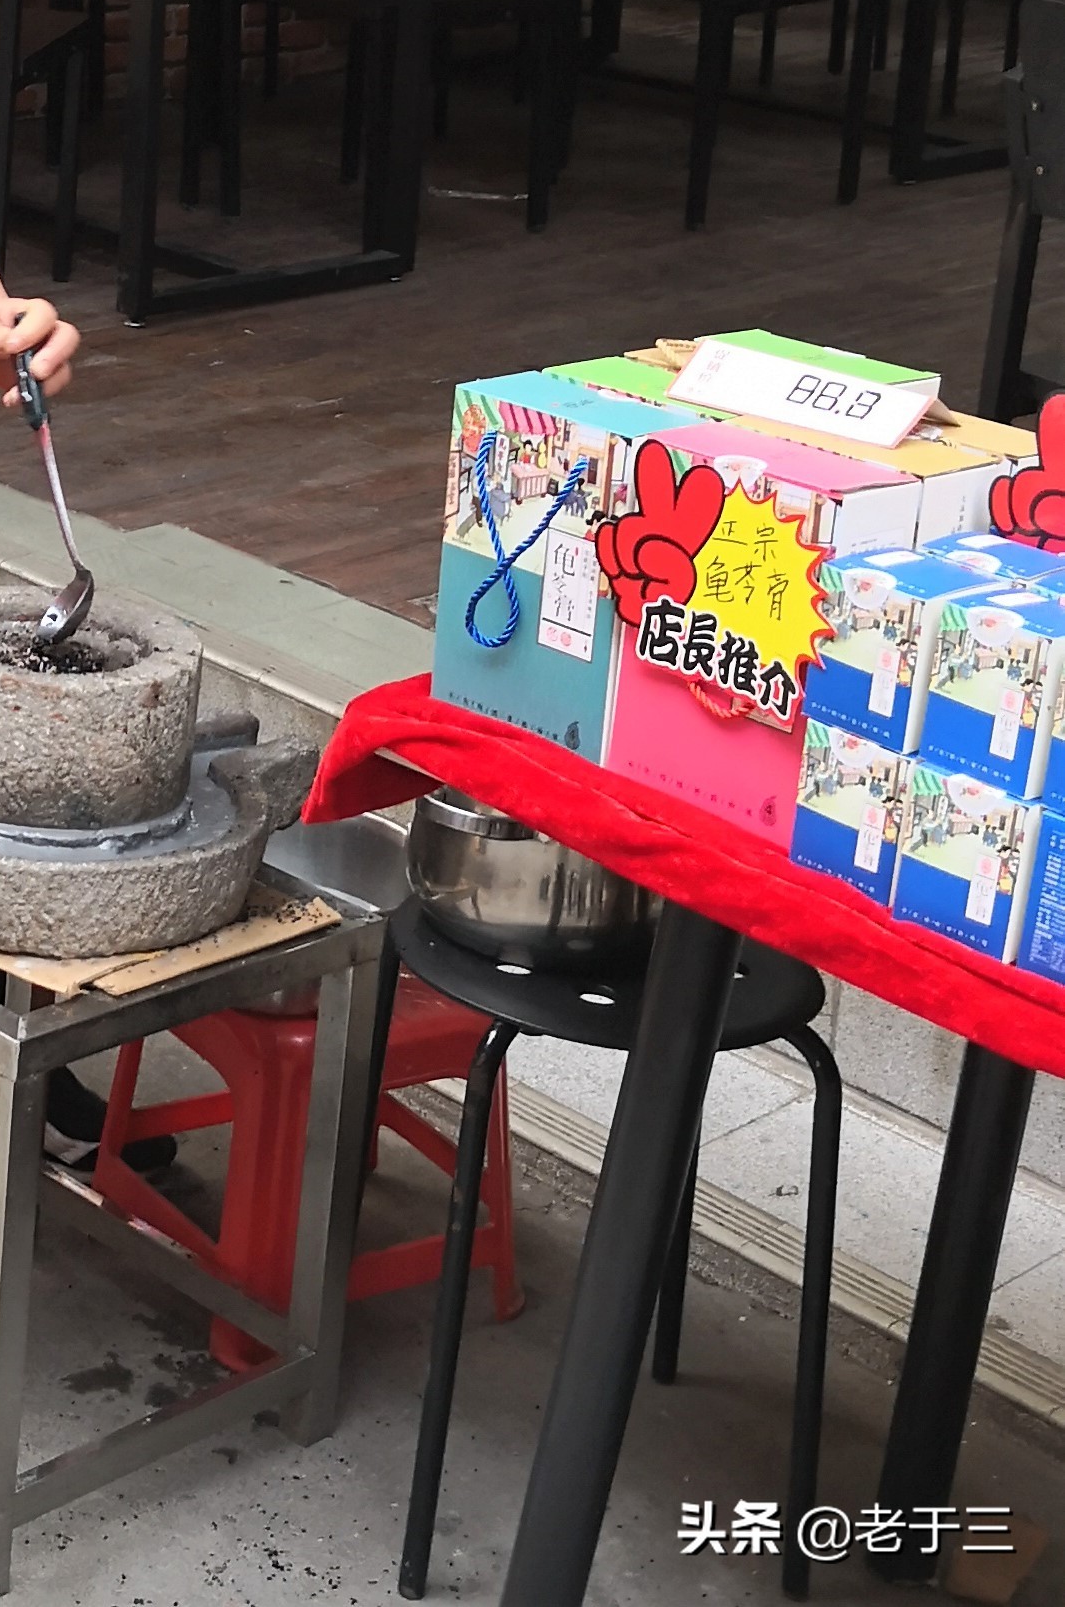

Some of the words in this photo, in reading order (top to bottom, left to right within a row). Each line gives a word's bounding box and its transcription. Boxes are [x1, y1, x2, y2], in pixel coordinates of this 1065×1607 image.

[712, 520, 779, 562] 正宗
[639, 598, 797, 717] 店長推介
